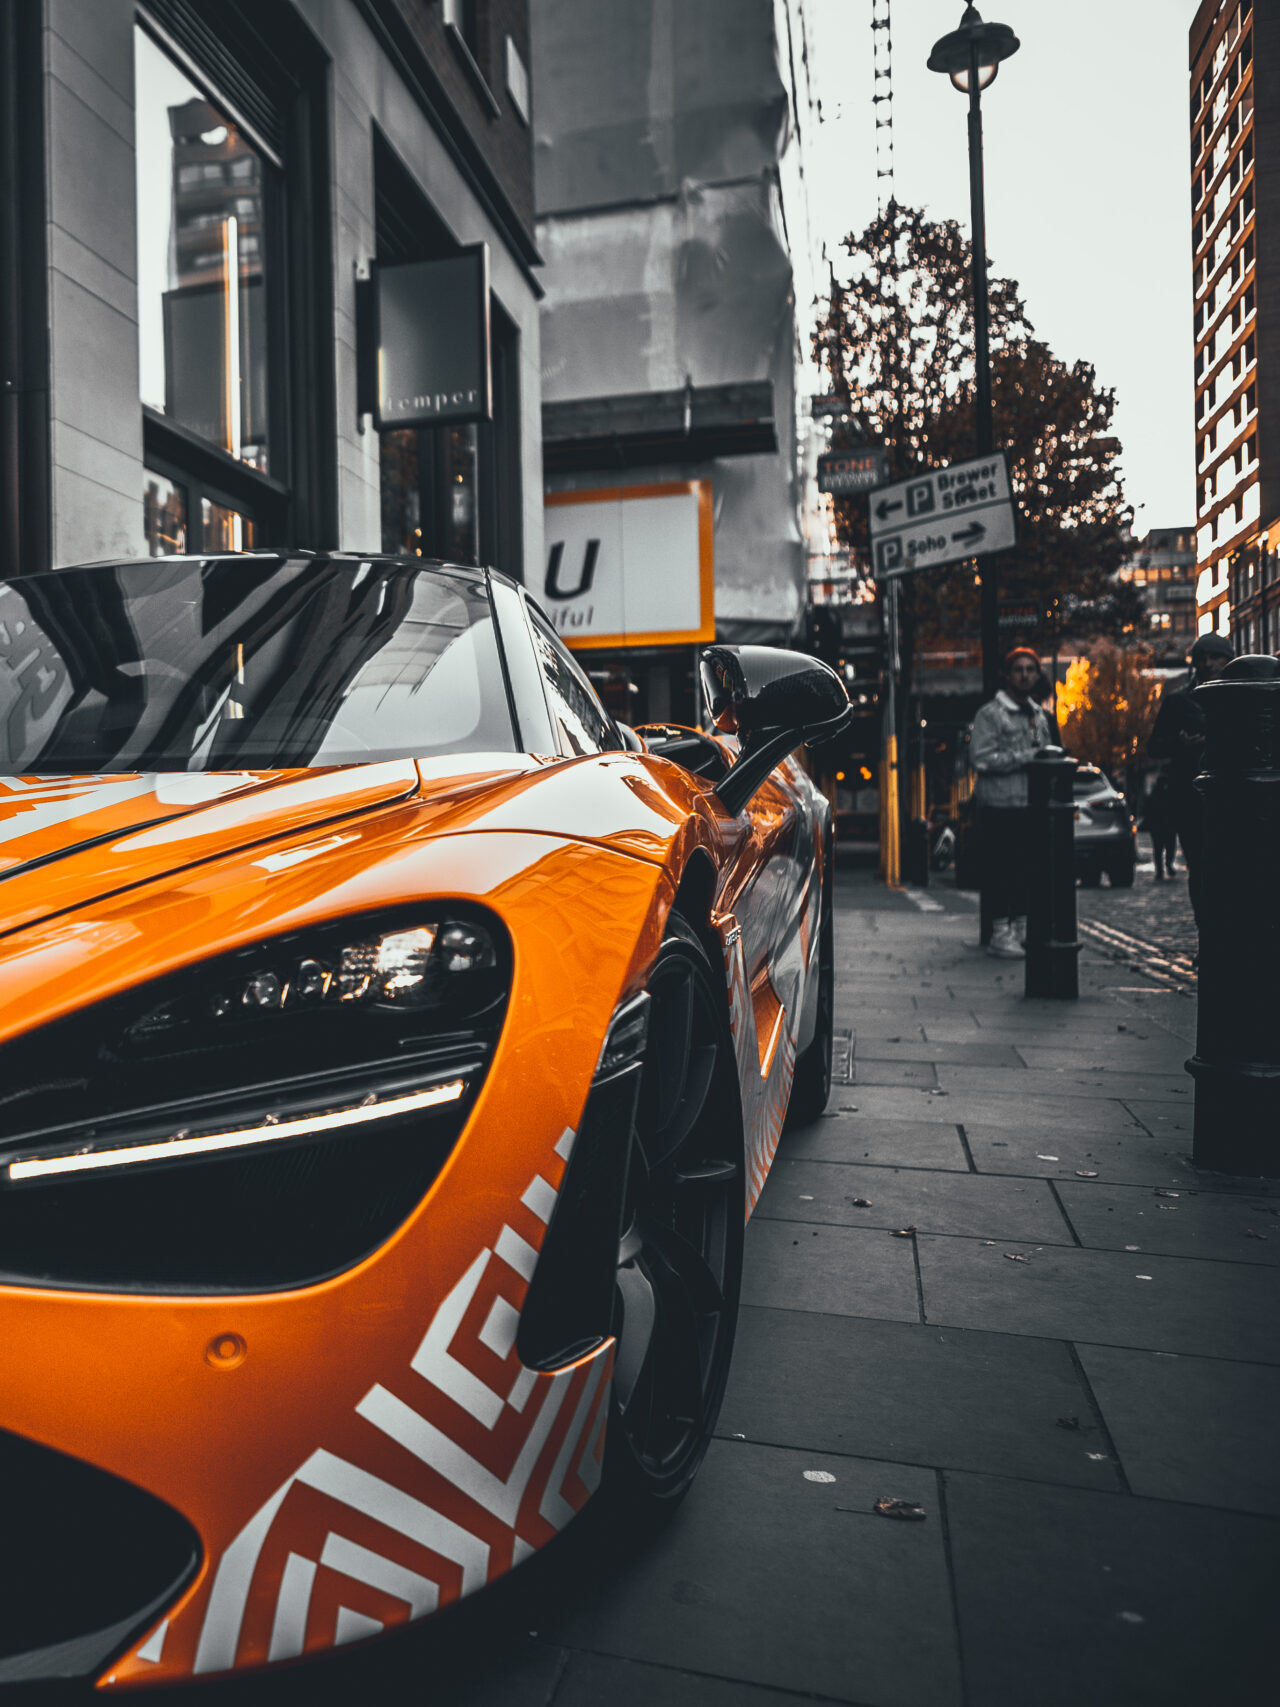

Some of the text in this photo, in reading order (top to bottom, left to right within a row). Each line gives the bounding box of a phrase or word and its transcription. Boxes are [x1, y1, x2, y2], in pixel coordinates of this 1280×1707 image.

[937, 463, 997, 491] Brewer
[942, 482, 997, 510] Street
[907, 535, 947, 557] Soho
